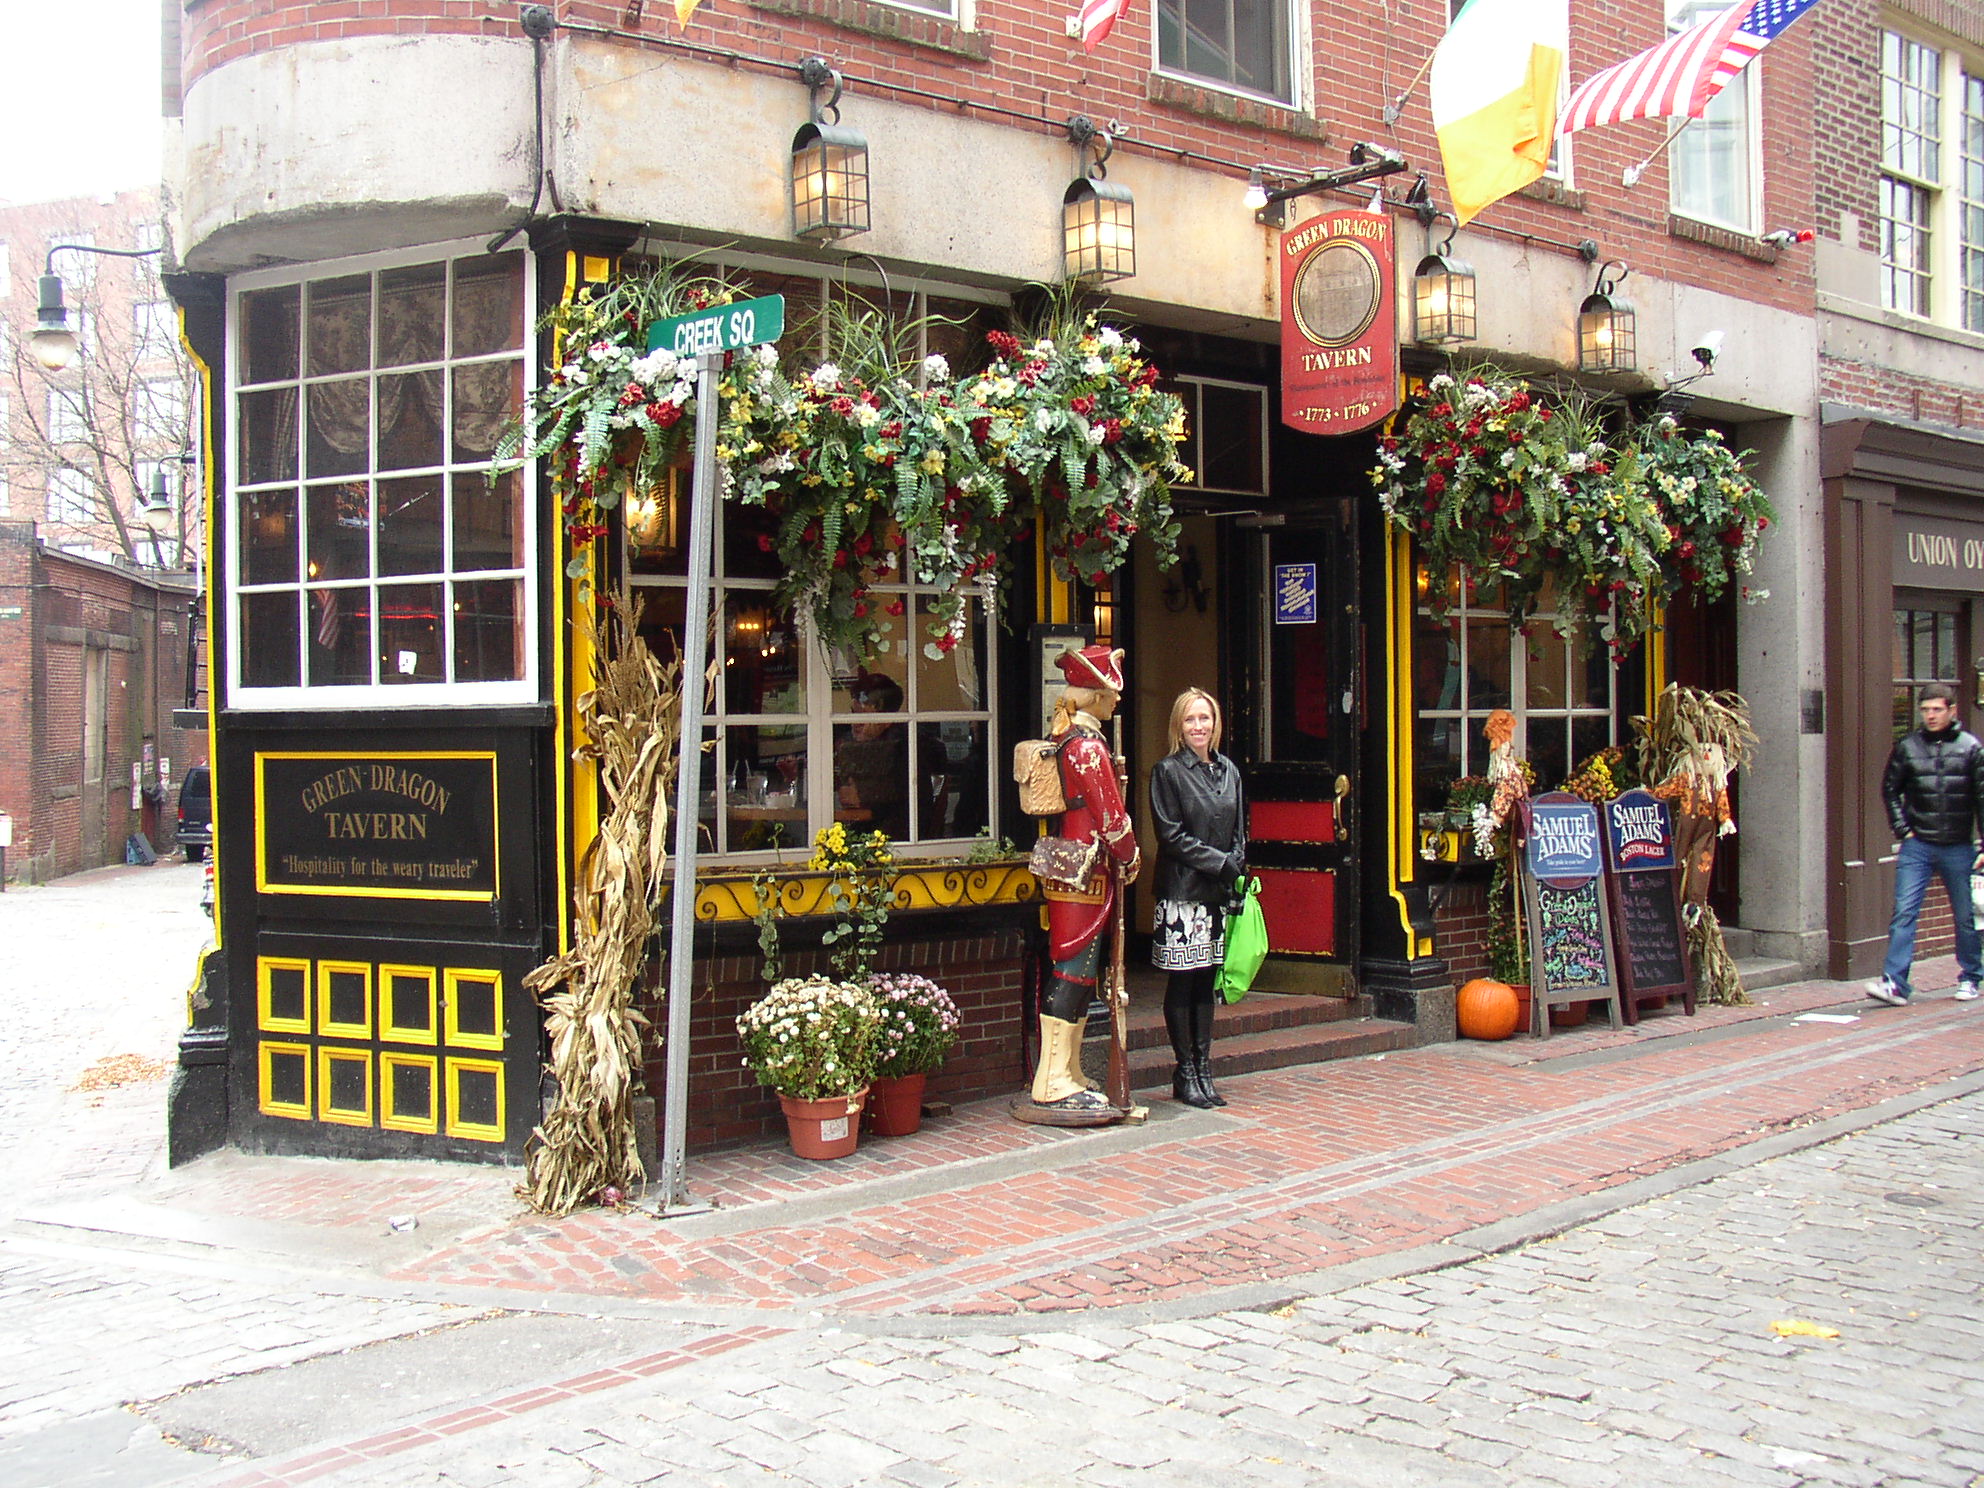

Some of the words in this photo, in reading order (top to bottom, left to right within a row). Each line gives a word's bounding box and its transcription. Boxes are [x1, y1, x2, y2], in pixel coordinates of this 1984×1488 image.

[1286, 221, 1329, 256] GREEN
[1333, 218, 1387, 242] DRAGON
[674, 315, 725, 356] CREEK
[729, 309, 755, 347] SQ
[1301, 346, 1373, 372] TAVERN
[1304, 407, 1331, 422] 1773
[1343, 401, 1370, 420] 1776
[1907, 532, 1957, 569] UNION
[301, 765, 362, 814] GREEN
[370, 764, 451, 816] DRAGON
[324, 812, 428, 840] TAVERN
[1532, 813, 1596, 840] SAMUEL
[1613, 803, 1665, 829] SAMUEL
[1620, 823, 1664, 848] ADAMS
[1537, 837, 1593, 862] ADAMS
[351, 857, 366, 875] for
[371, 858, 388, 876] the
[393, 861, 424, 881] weary
